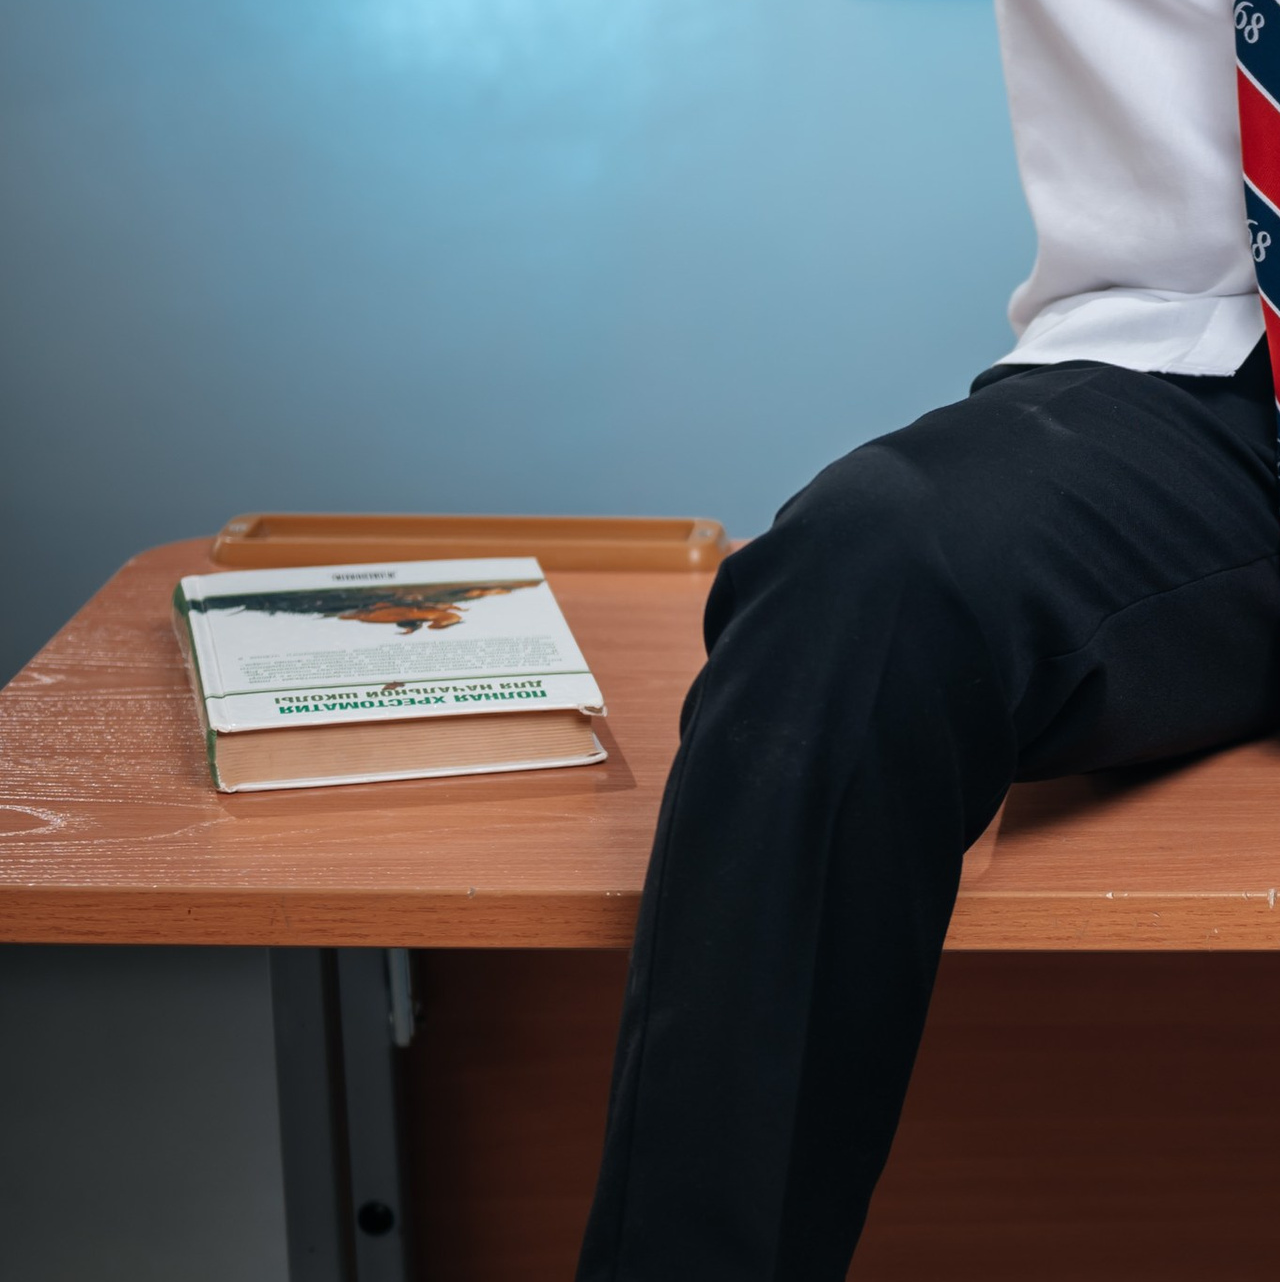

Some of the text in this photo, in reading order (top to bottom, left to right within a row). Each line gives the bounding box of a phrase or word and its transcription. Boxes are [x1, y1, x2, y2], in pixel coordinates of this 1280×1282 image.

[274, 680, 543, 705] ДЛЯ НАЧАЛЬНОЙ ШКОЛЫ
[278, 689, 548, 715] ПОЛНАЯ ХРЕСТОМАТИЯ
